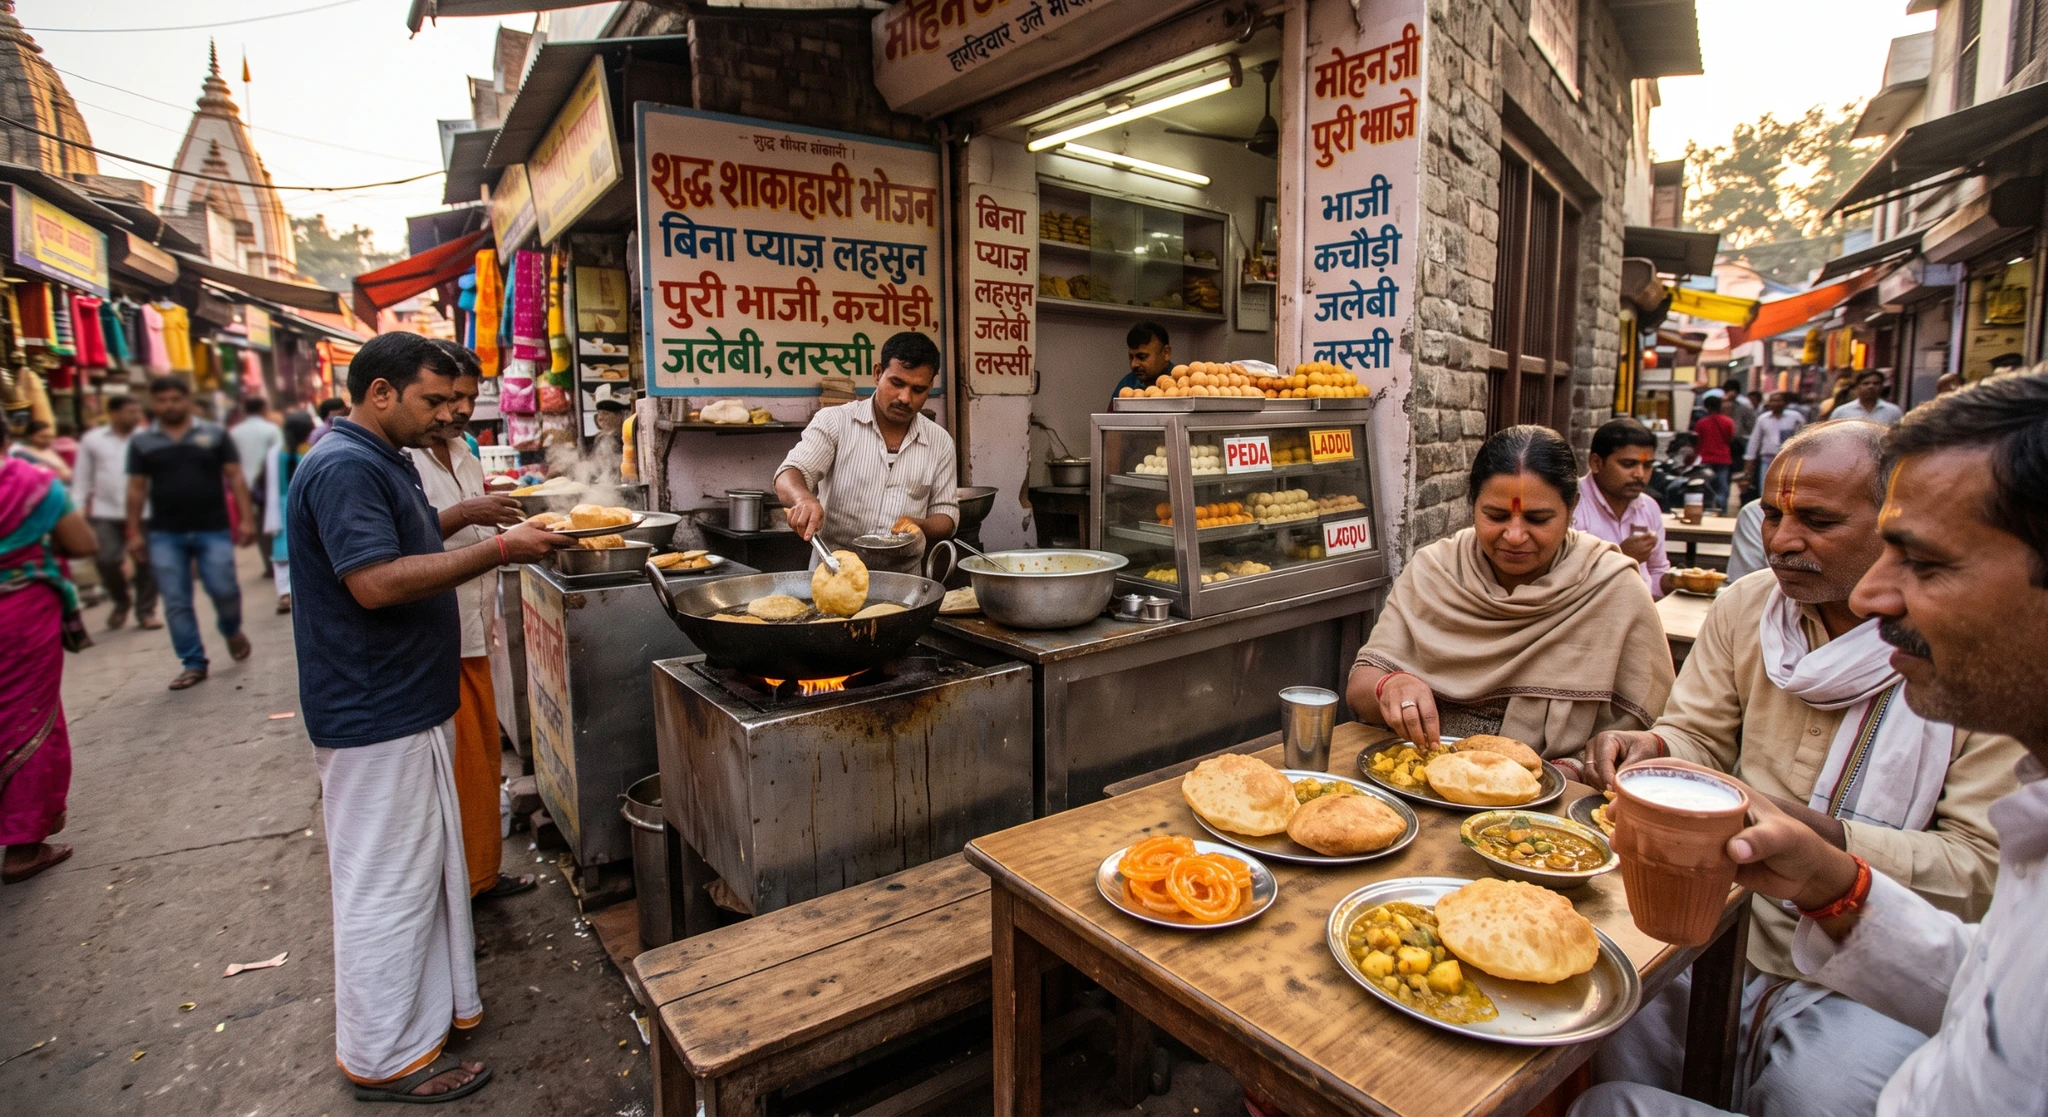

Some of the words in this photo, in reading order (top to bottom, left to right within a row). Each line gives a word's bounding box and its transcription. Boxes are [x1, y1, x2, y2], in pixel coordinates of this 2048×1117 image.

[1311, 103, 1357, 168] पुरी
[1359, 88, 1418, 145] भाजे
[651, 152, 715, 210] शुद्ध
[719, 161, 855, 221] शाकाहारी
[860, 168, 937, 228] भोजन
[1321, 173, 1392, 223] भाजी
[975, 194, 1027, 235] बिना
[659, 211, 737, 262] बिना
[744, 229, 826, 274] प्याज़
[832, 237, 927, 285] लहसुन
[974, 240, 1030, 276] प्याज़
[1314, 223, 1403, 273] कचौड़ी
[659, 270, 727, 329] पुरी
[735, 276, 829, 328] भाजी,
[832, 283, 939, 333] कचौड़ी,
[974, 279, 1034, 312] लहसुन
[1314, 276, 1399, 322] जलेबी
[974, 309, 1030, 342] जलेबी
[662, 326, 773, 379] जलेबी,
[776, 331, 875, 376] लस्सी
[974, 345, 1032, 376] लस्सी
[1313, 327, 1394, 370] लस्सी
[1227, 442, 1270, 467] PEDA
[1311, 433, 1351, 455] LADDU
